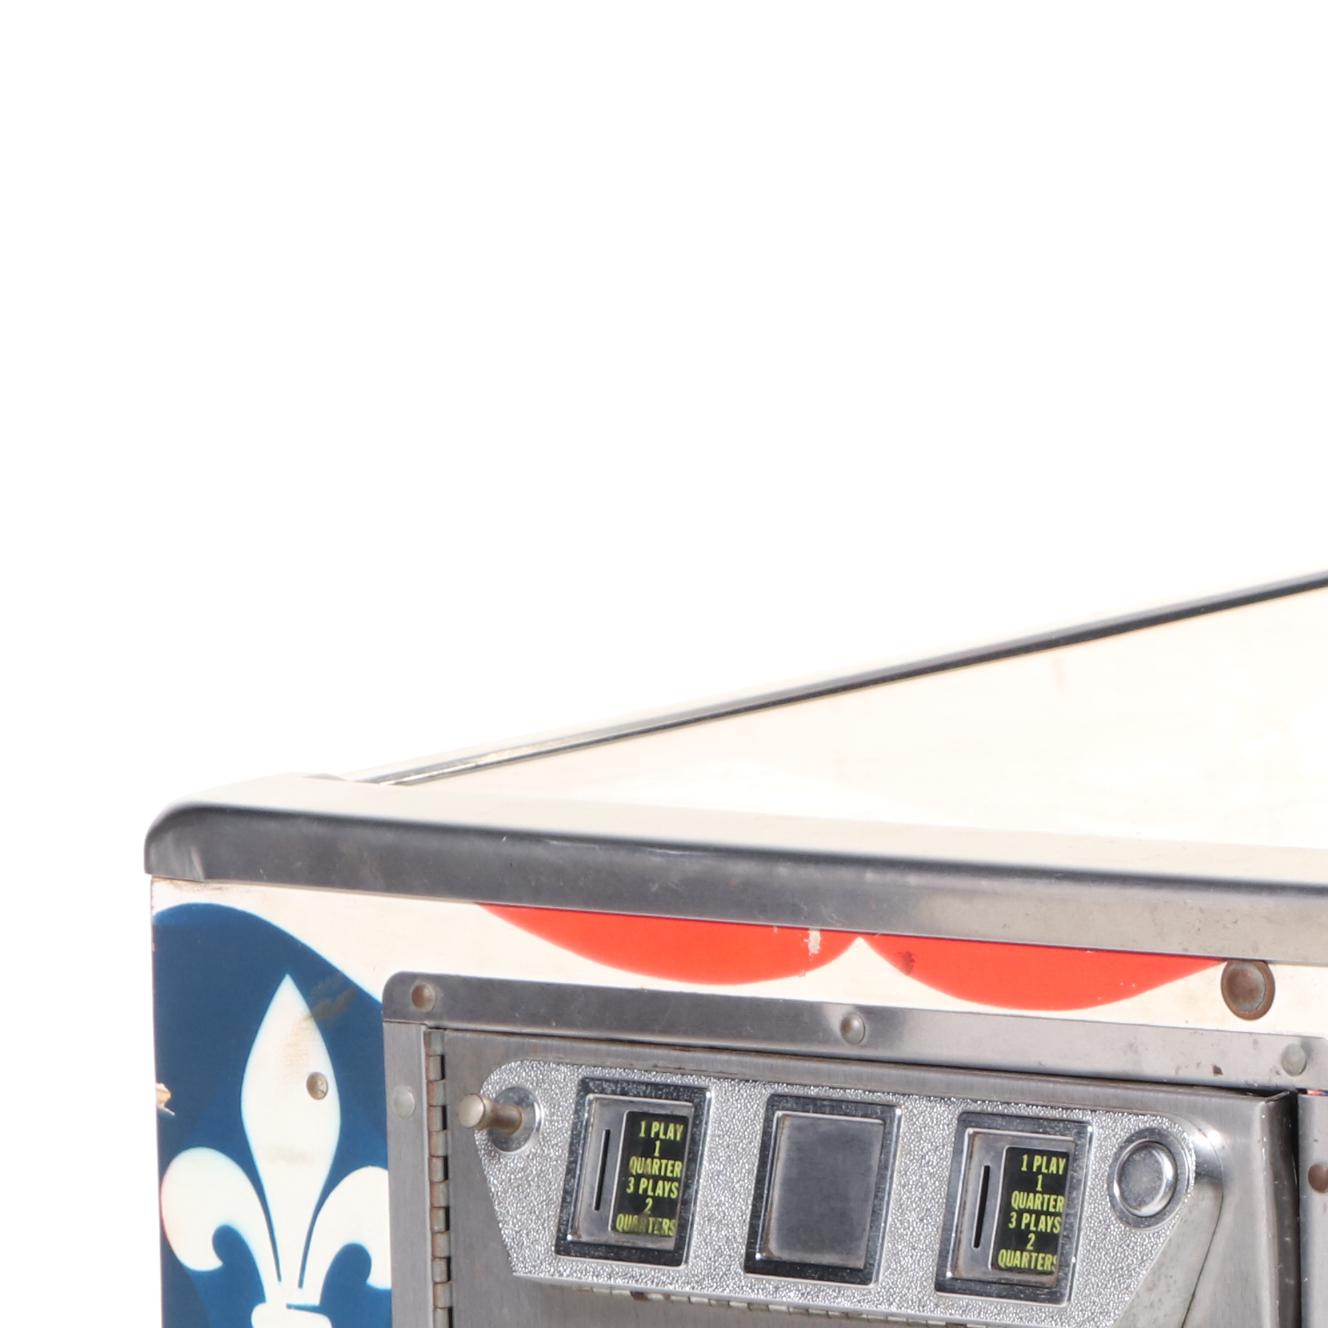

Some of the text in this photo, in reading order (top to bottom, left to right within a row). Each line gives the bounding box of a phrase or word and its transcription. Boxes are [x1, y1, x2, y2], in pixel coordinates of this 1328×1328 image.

[639, 1121, 684, 1141] 1 PLAY
[654, 1141, 660, 1156] 1
[629, 1156, 683, 1178] QUARTER
[1021, 1155, 1067, 1176] 1 PLAY
[626, 1178, 680, 1199] 3 PLAYS
[1036, 1175, 1043, 1191] 1
[644, 1198, 652, 1214] 2
[1011, 1191, 1065, 1213] QUARTER
[1008, 1212, 1062, 1234] 3 PLAYS
[1026, 1233, 1035, 1249] 2
